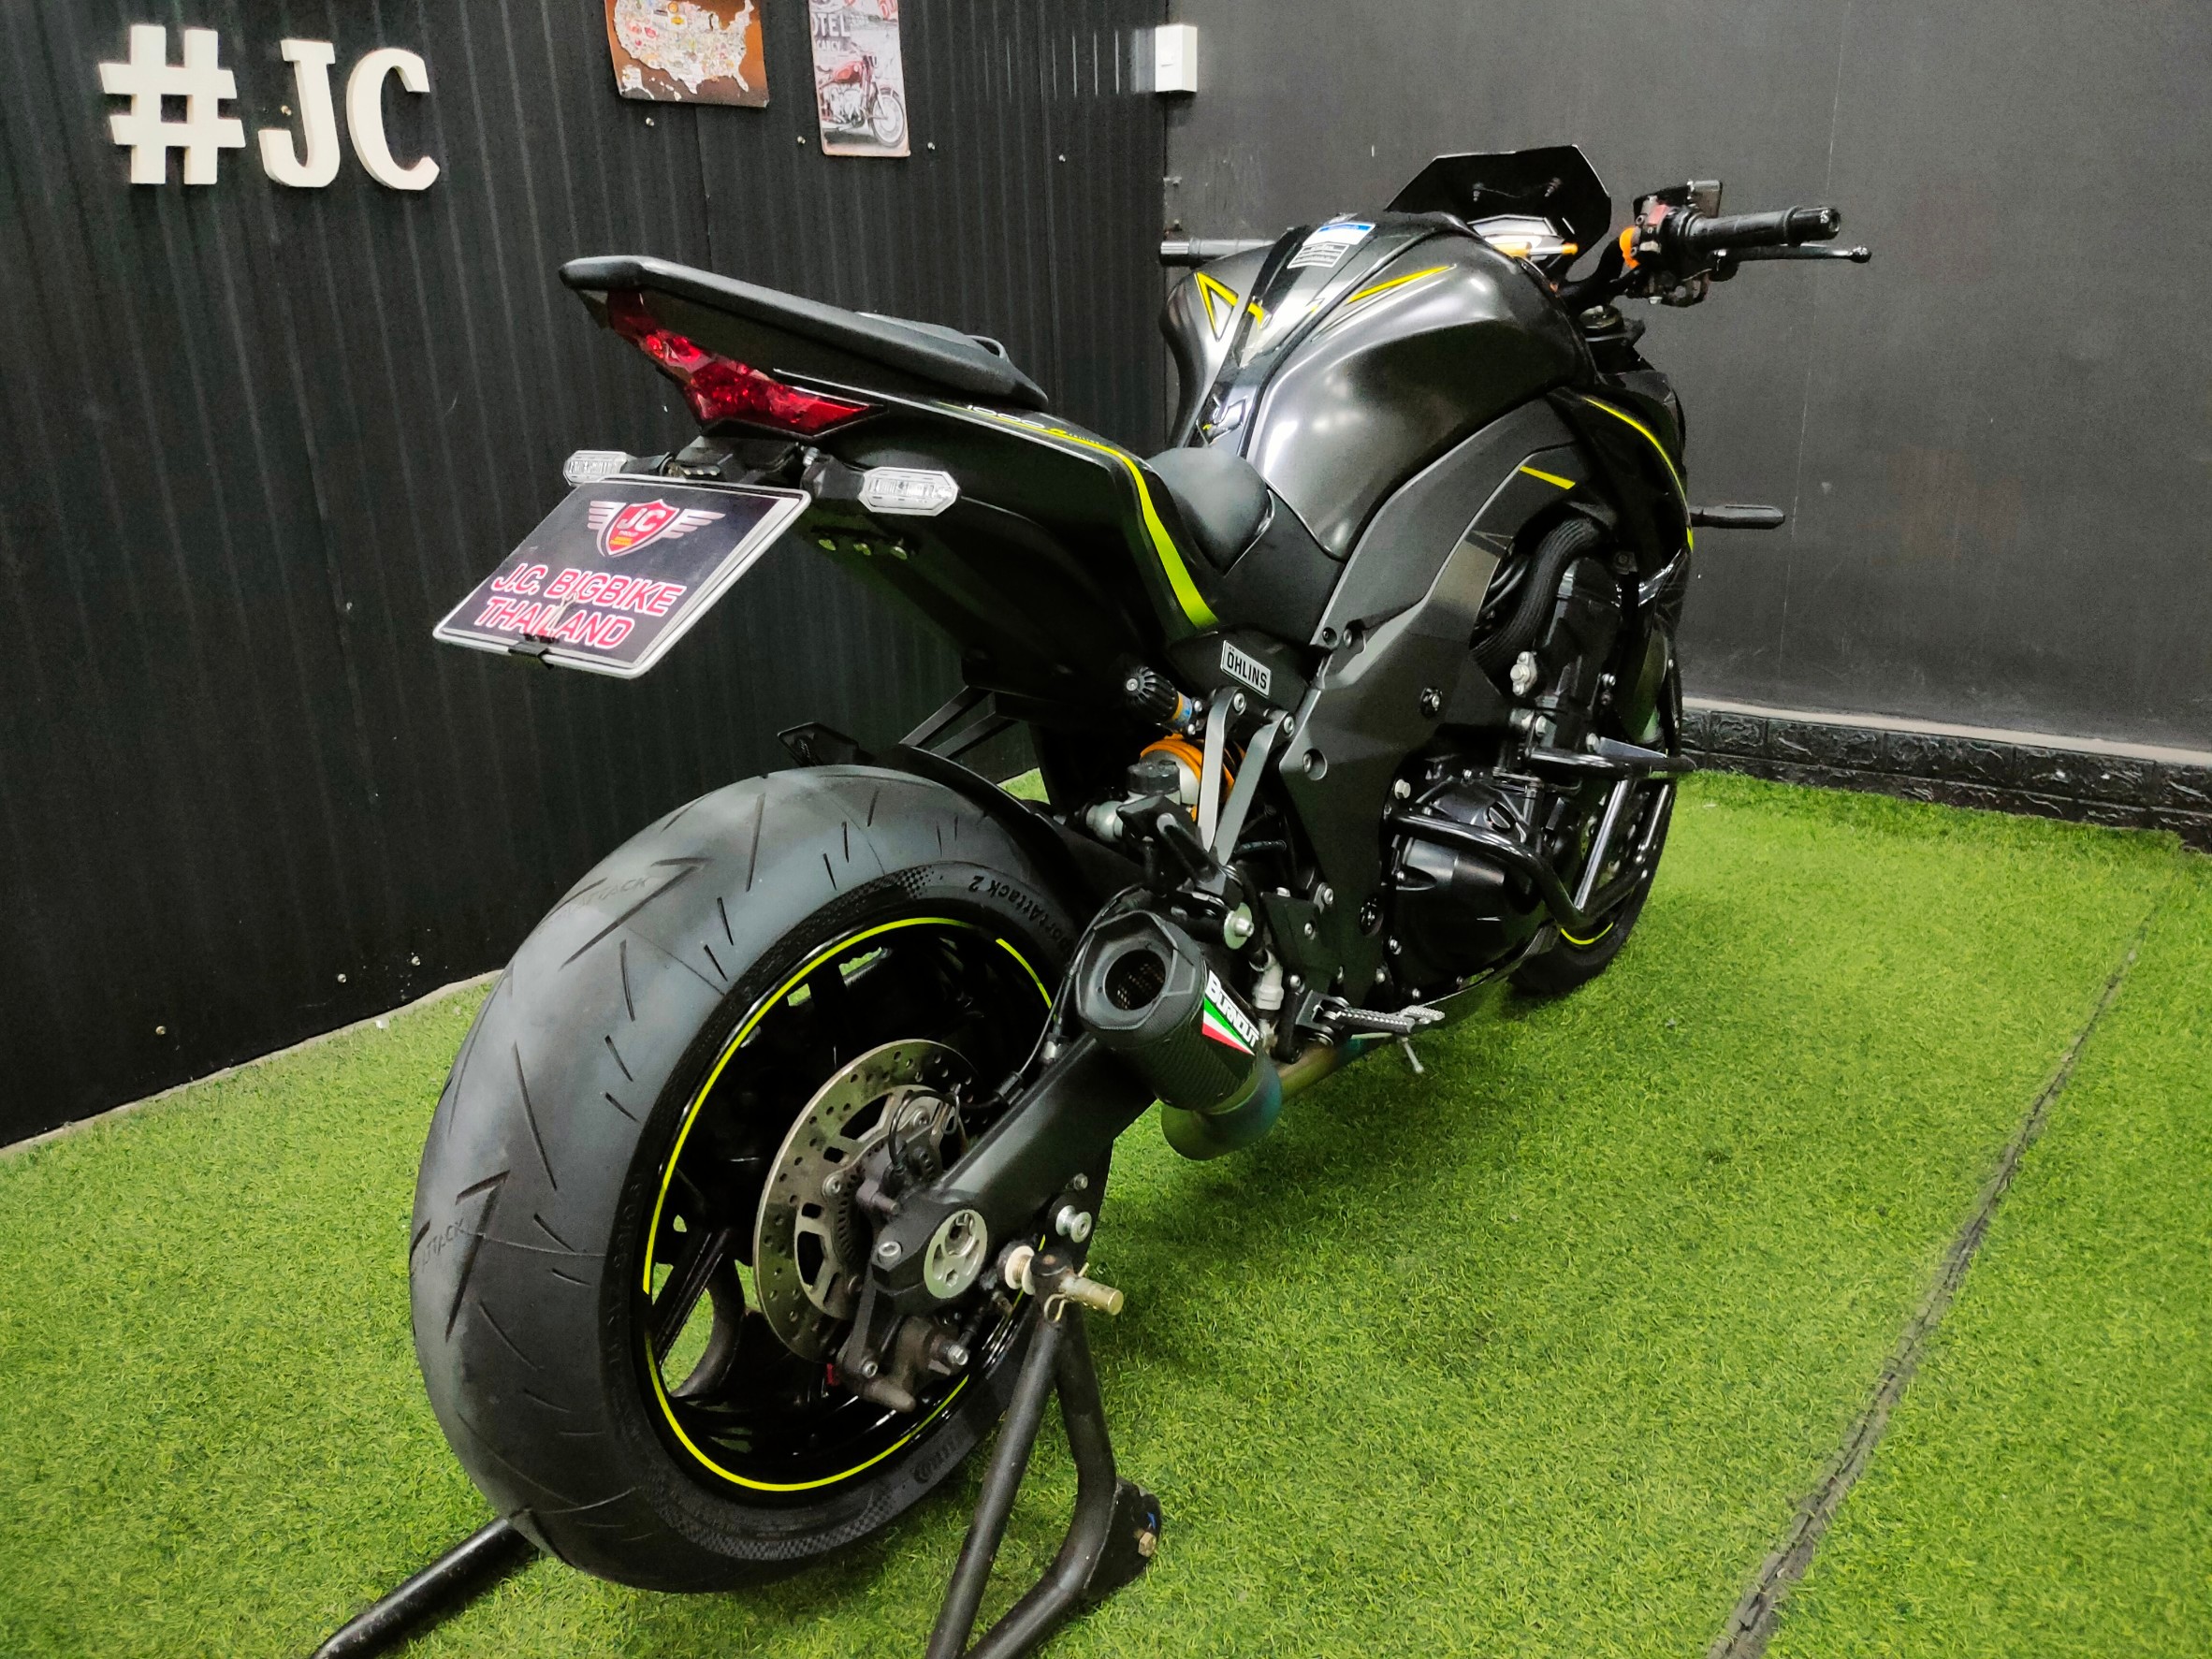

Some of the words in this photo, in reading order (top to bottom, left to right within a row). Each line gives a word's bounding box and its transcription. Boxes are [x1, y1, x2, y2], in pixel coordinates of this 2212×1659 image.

[99, 24, 440, 191] #JC
[617, 508, 666, 531] JC
[491, 562, 548, 597] J.C.
[543, 567, 687, 618] BIGBIKE
[473, 596, 635, 649] THAILAND
[1227, 646, 1268, 690] ÖHLINS
[968, 875, 985, 893] 2
[1204, 969, 1259, 1048] BURNOUT
